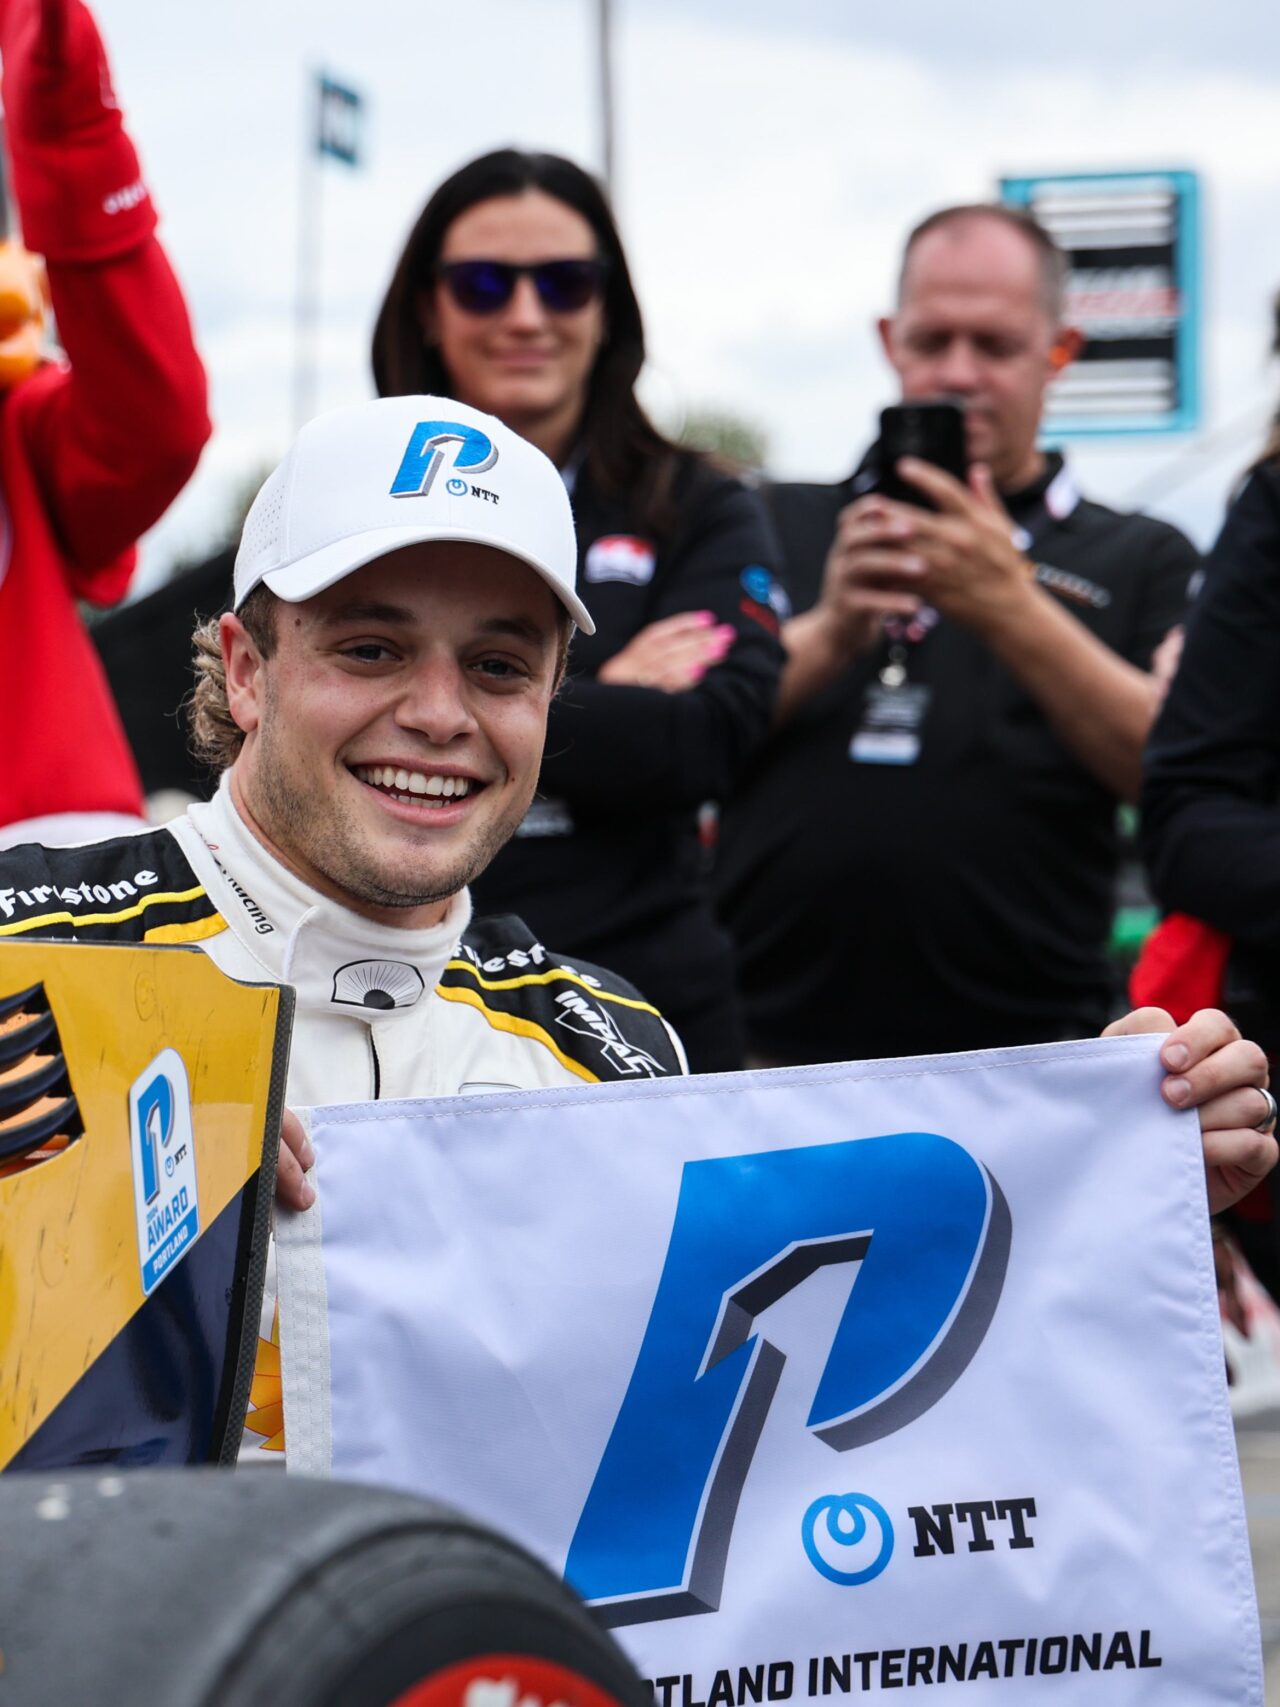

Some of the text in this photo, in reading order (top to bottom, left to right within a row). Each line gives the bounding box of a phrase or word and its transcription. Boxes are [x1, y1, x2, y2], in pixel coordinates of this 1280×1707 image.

[471, 485, 500, 505] NTT
[147, 1185, 189, 1252] AWARD
[152, 1226, 189, 1275] PORTLAND
[908, 1497, 1037, 1557] NTT
[644, 1661, 794, 1707] TLAND
[808, 1629, 1163, 1699] INTERNATIONAL
